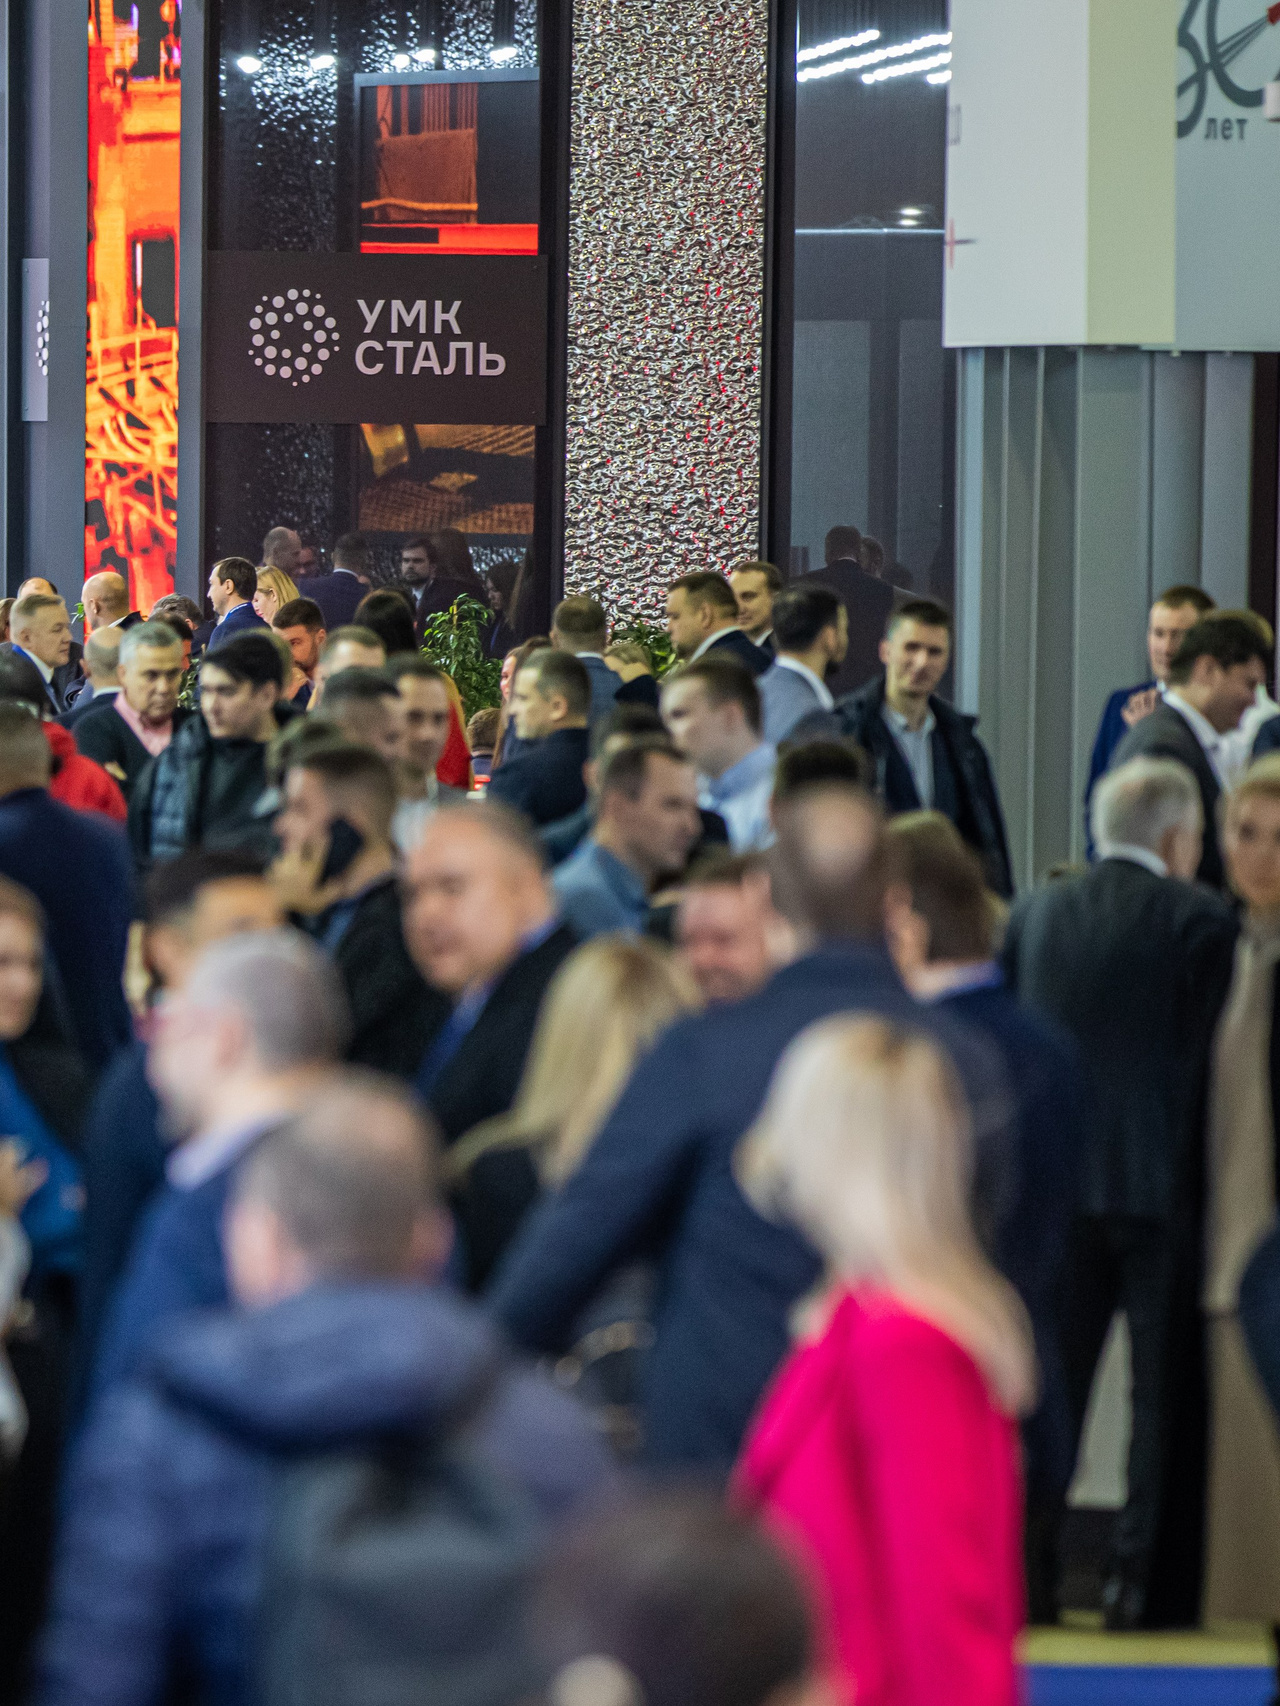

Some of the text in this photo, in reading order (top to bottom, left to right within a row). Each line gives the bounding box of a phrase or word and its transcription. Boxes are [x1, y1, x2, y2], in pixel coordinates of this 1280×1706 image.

[1205, 117, 1247, 140] лет
[357, 299, 462, 334] УМК
[355, 340, 506, 376] СТАЛЬ
